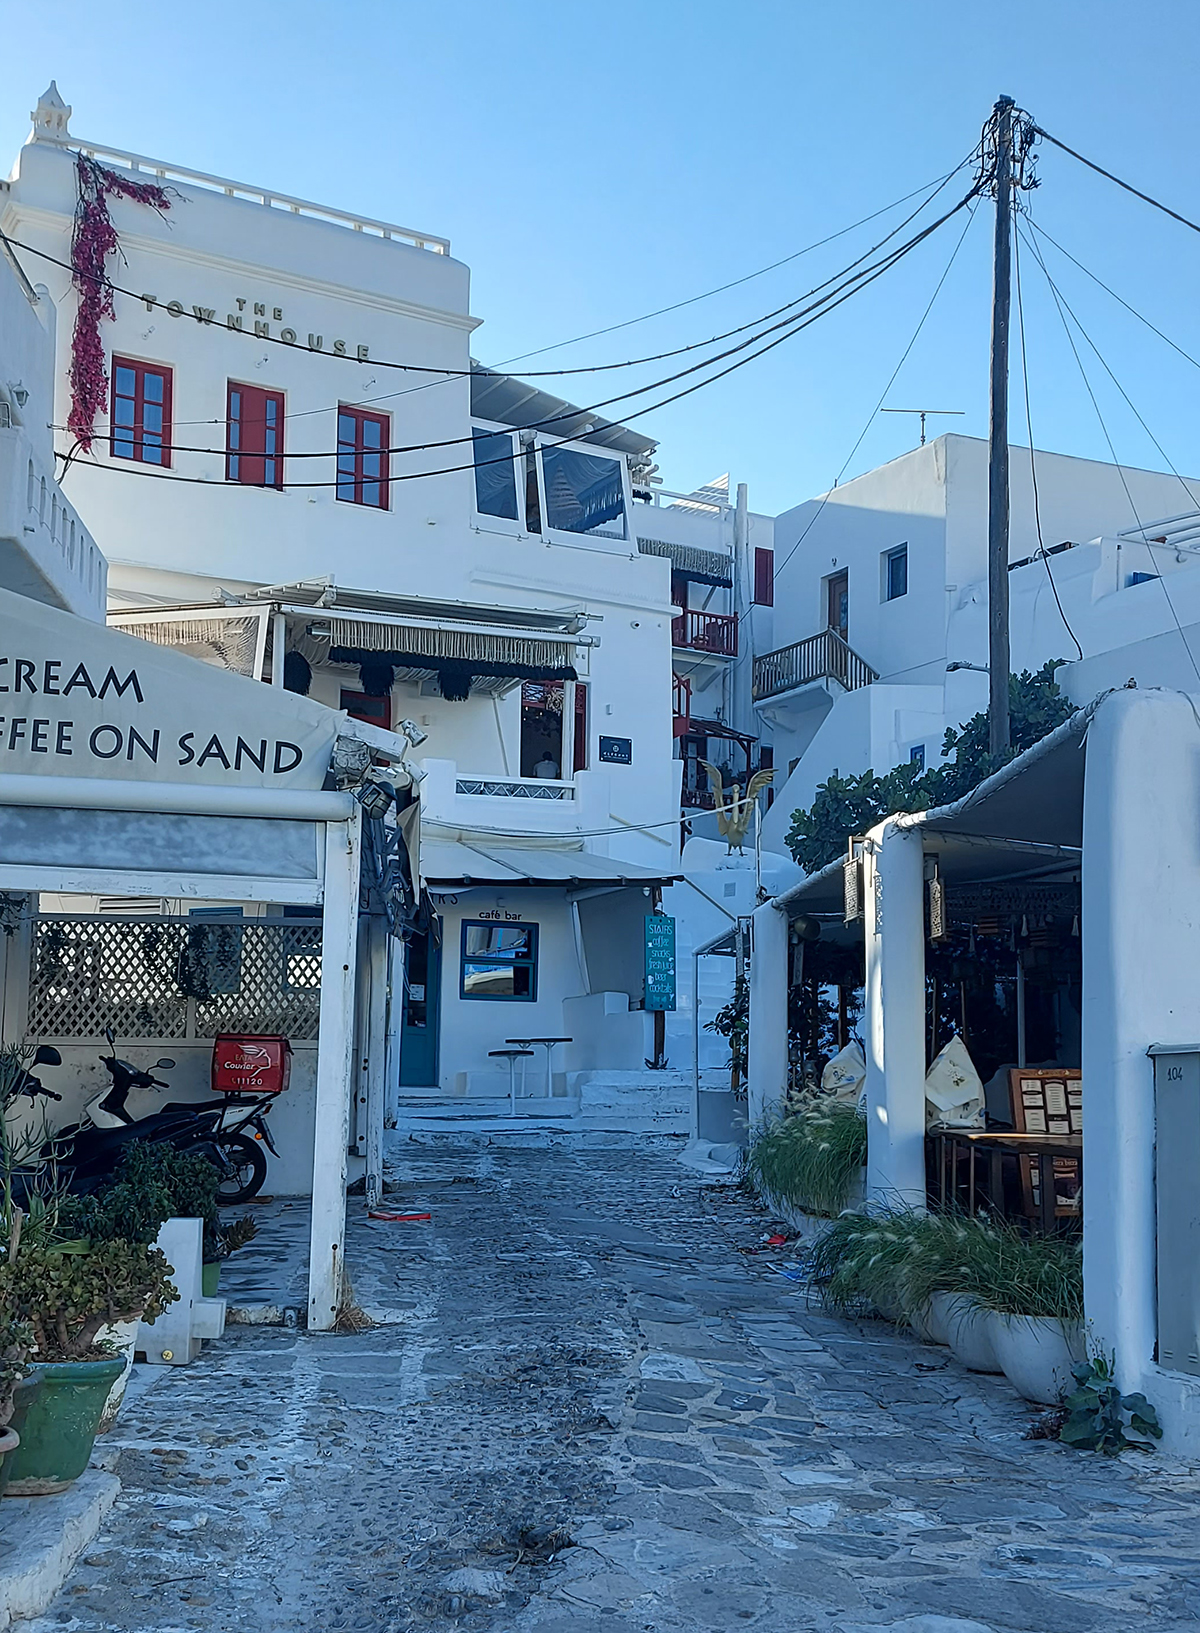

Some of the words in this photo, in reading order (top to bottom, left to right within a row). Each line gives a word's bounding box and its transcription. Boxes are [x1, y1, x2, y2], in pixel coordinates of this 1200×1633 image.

[236, 298, 283, 321] THE
[142, 294, 370, 361] TOWNHOUSE
[89, 724, 161, 764] ON
[178, 732, 304, 774] SAND
[478, 909, 501, 920] café
[504, 910, 522, 921] bar
[648, 923, 673, 935] STAIRS
[224, 1061, 255, 1070] Courier
[1167, 1066, 1183, 1082] 104
[236, 1077, 263, 1086] 11120
